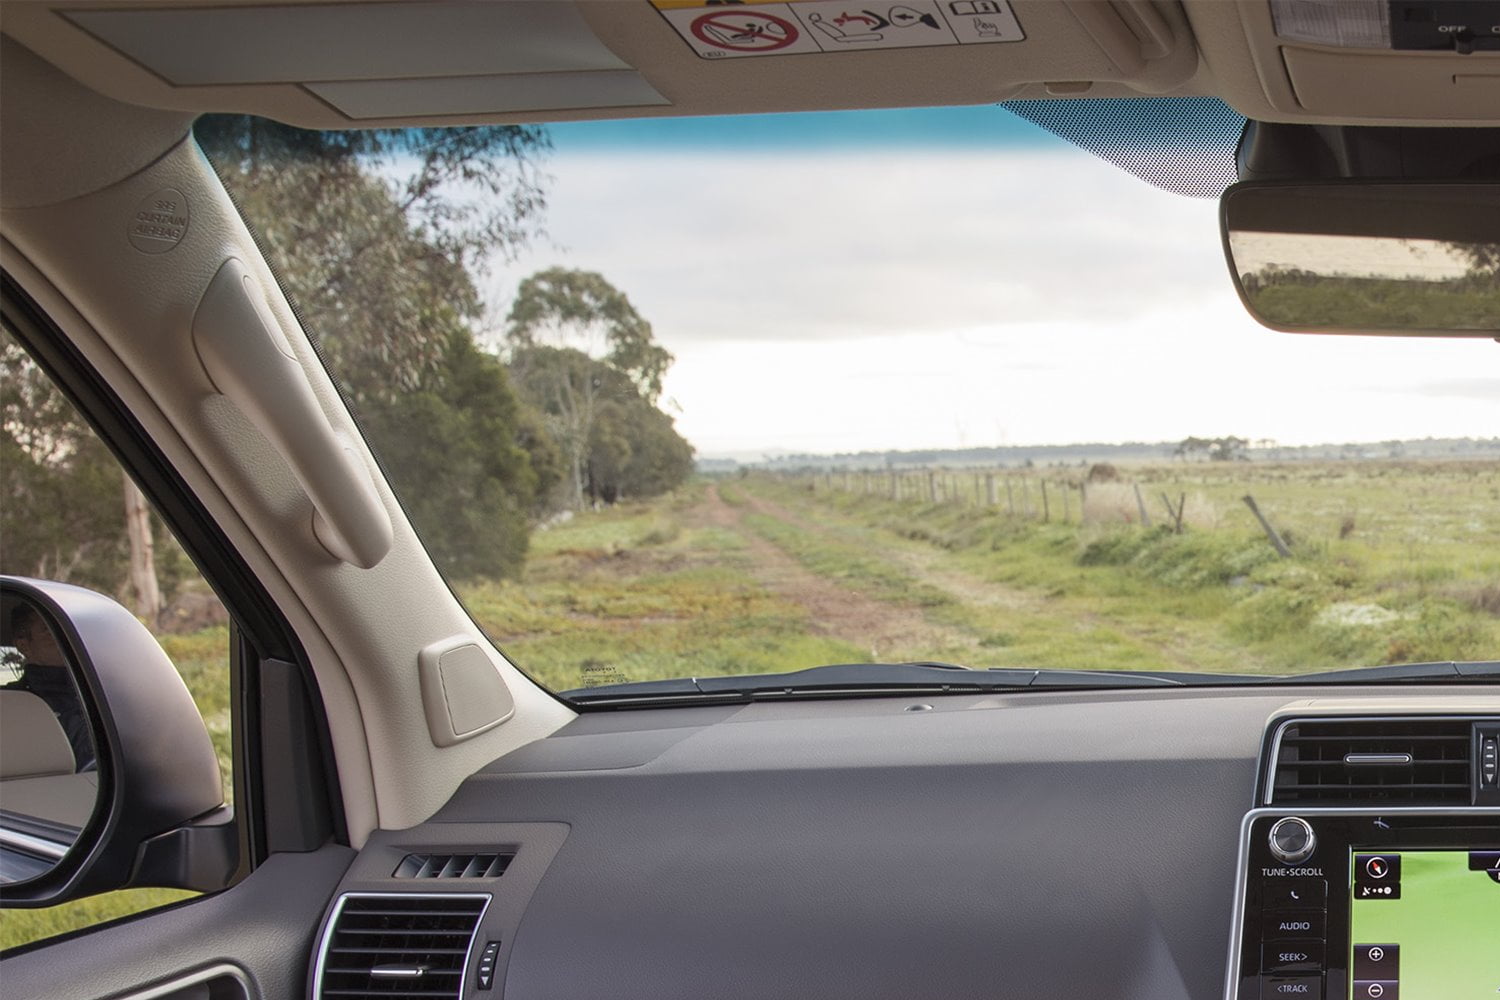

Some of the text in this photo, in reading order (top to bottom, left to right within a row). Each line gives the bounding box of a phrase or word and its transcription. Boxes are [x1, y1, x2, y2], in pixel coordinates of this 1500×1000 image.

[1438, 25, 1466, 33] OFF
[136, 211, 186, 226] CURTAIN
[135, 224, 180, 239] AIRBAG
[1279, 922, 1310, 930] AUDIO
